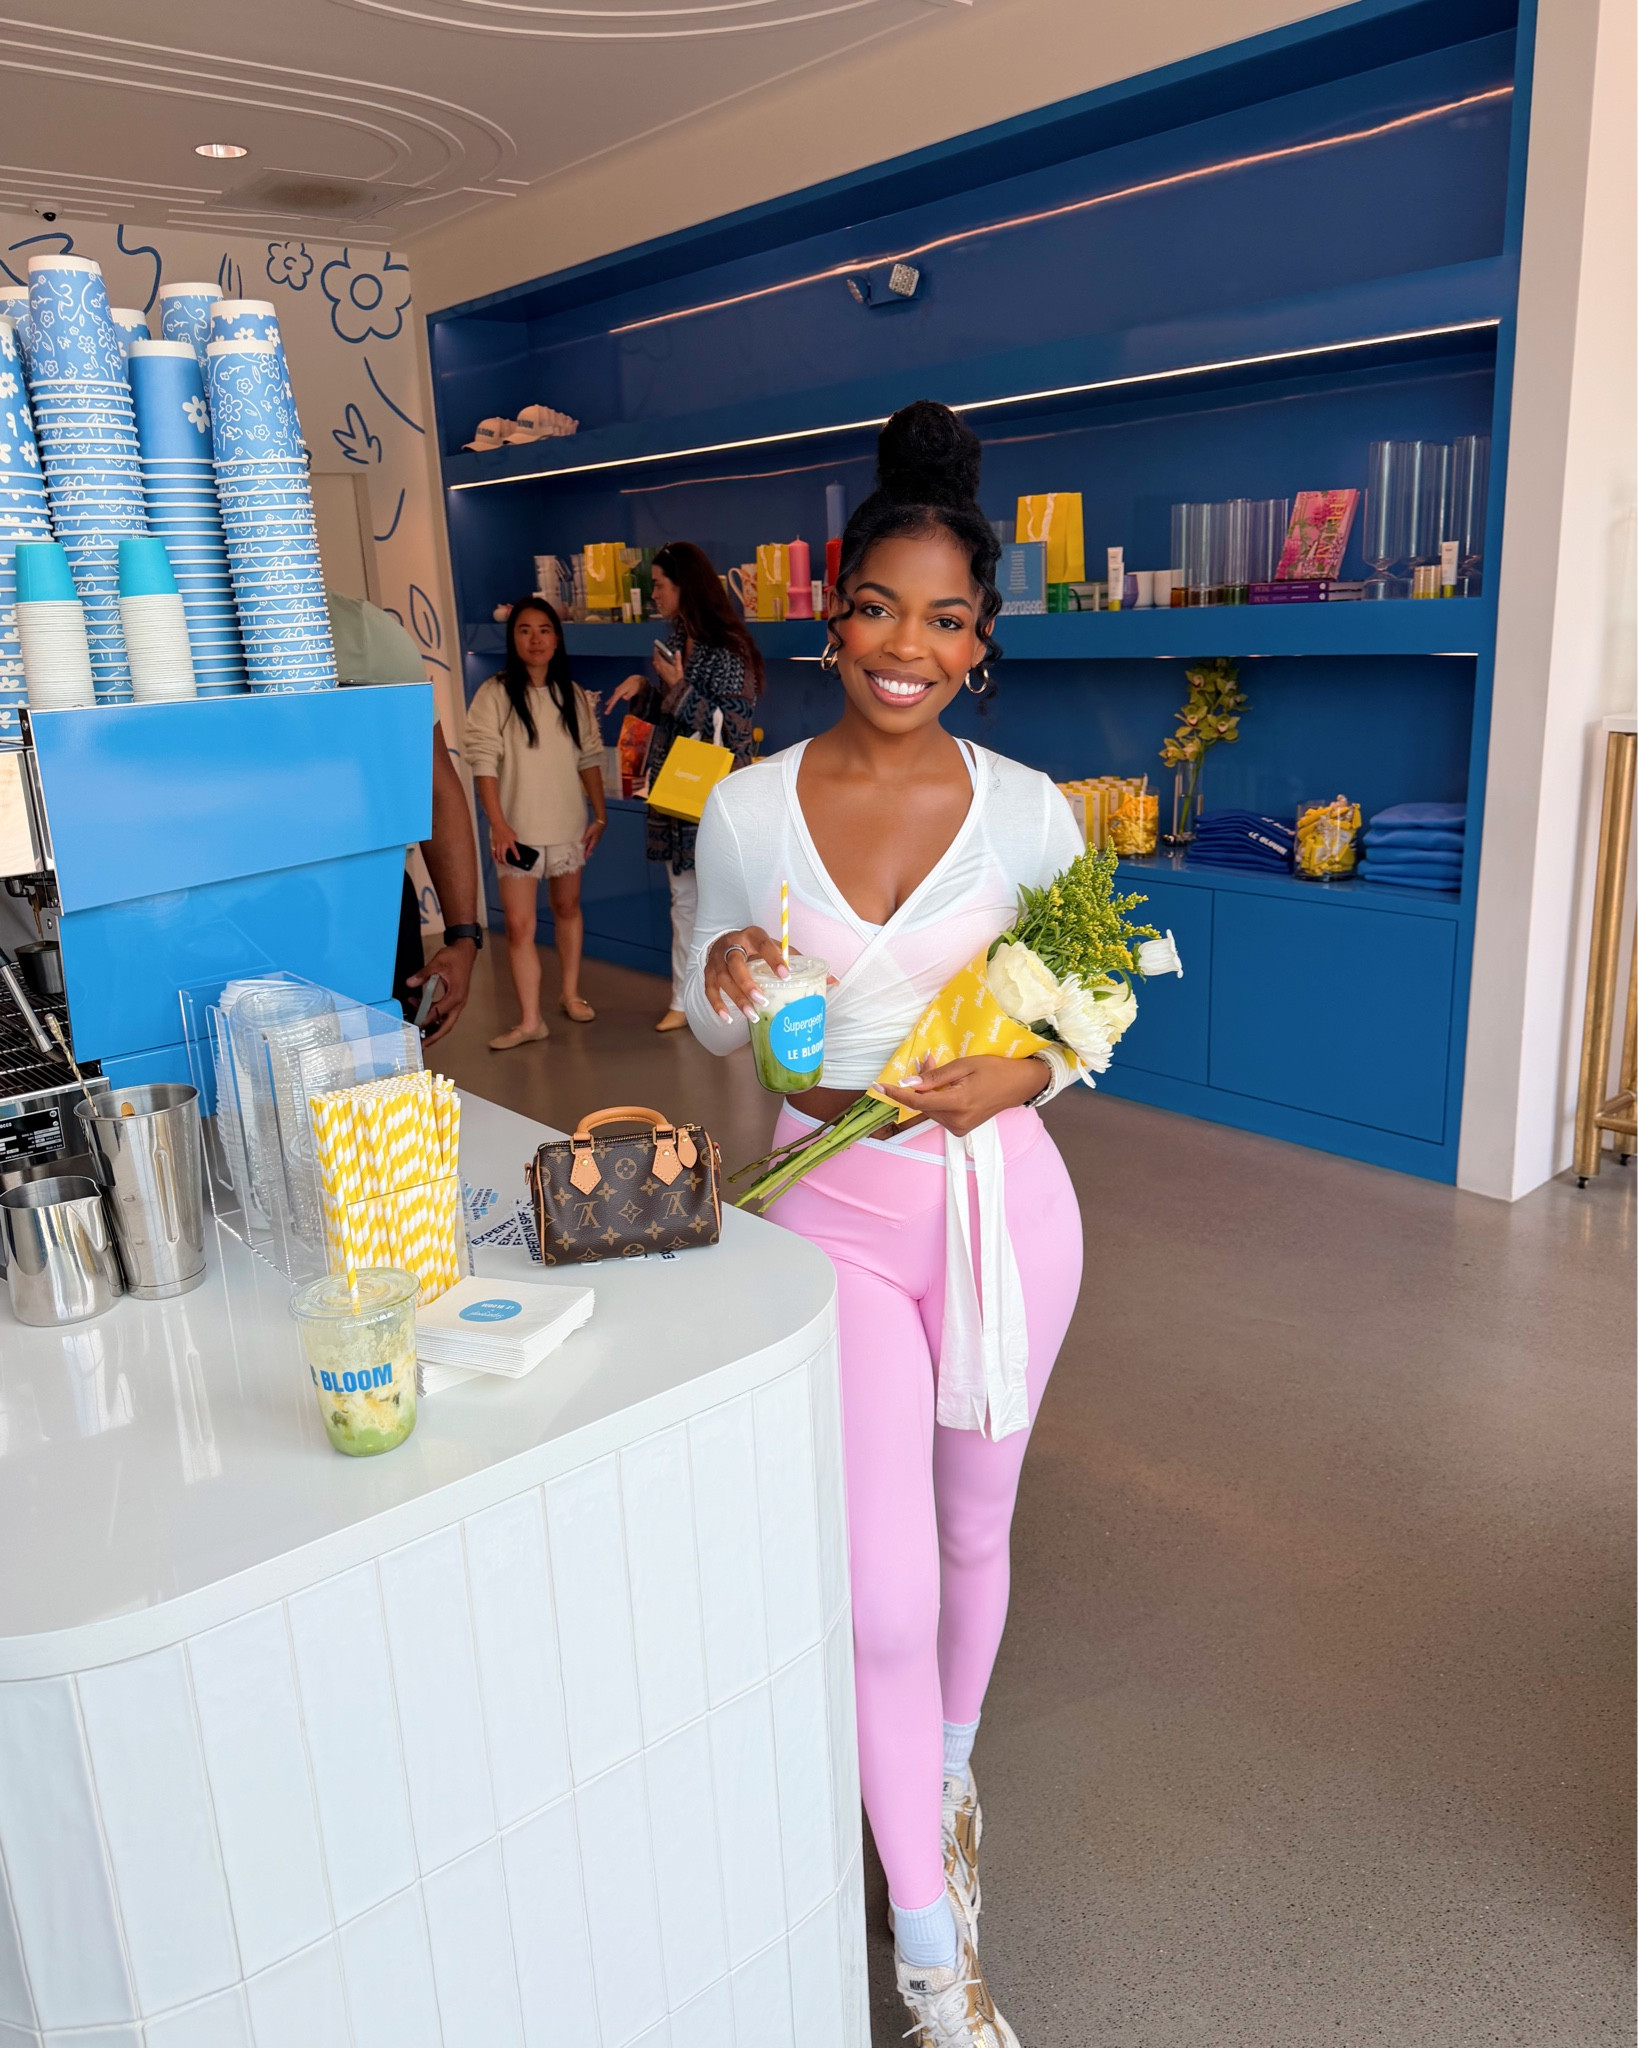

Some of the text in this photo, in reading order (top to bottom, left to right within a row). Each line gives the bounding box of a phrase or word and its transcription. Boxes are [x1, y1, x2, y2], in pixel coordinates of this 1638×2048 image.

[787, 1049, 799, 1060] LE
[320, 1362, 393, 1393] BLOOM
[909, 1979, 927, 1991] NIKE
